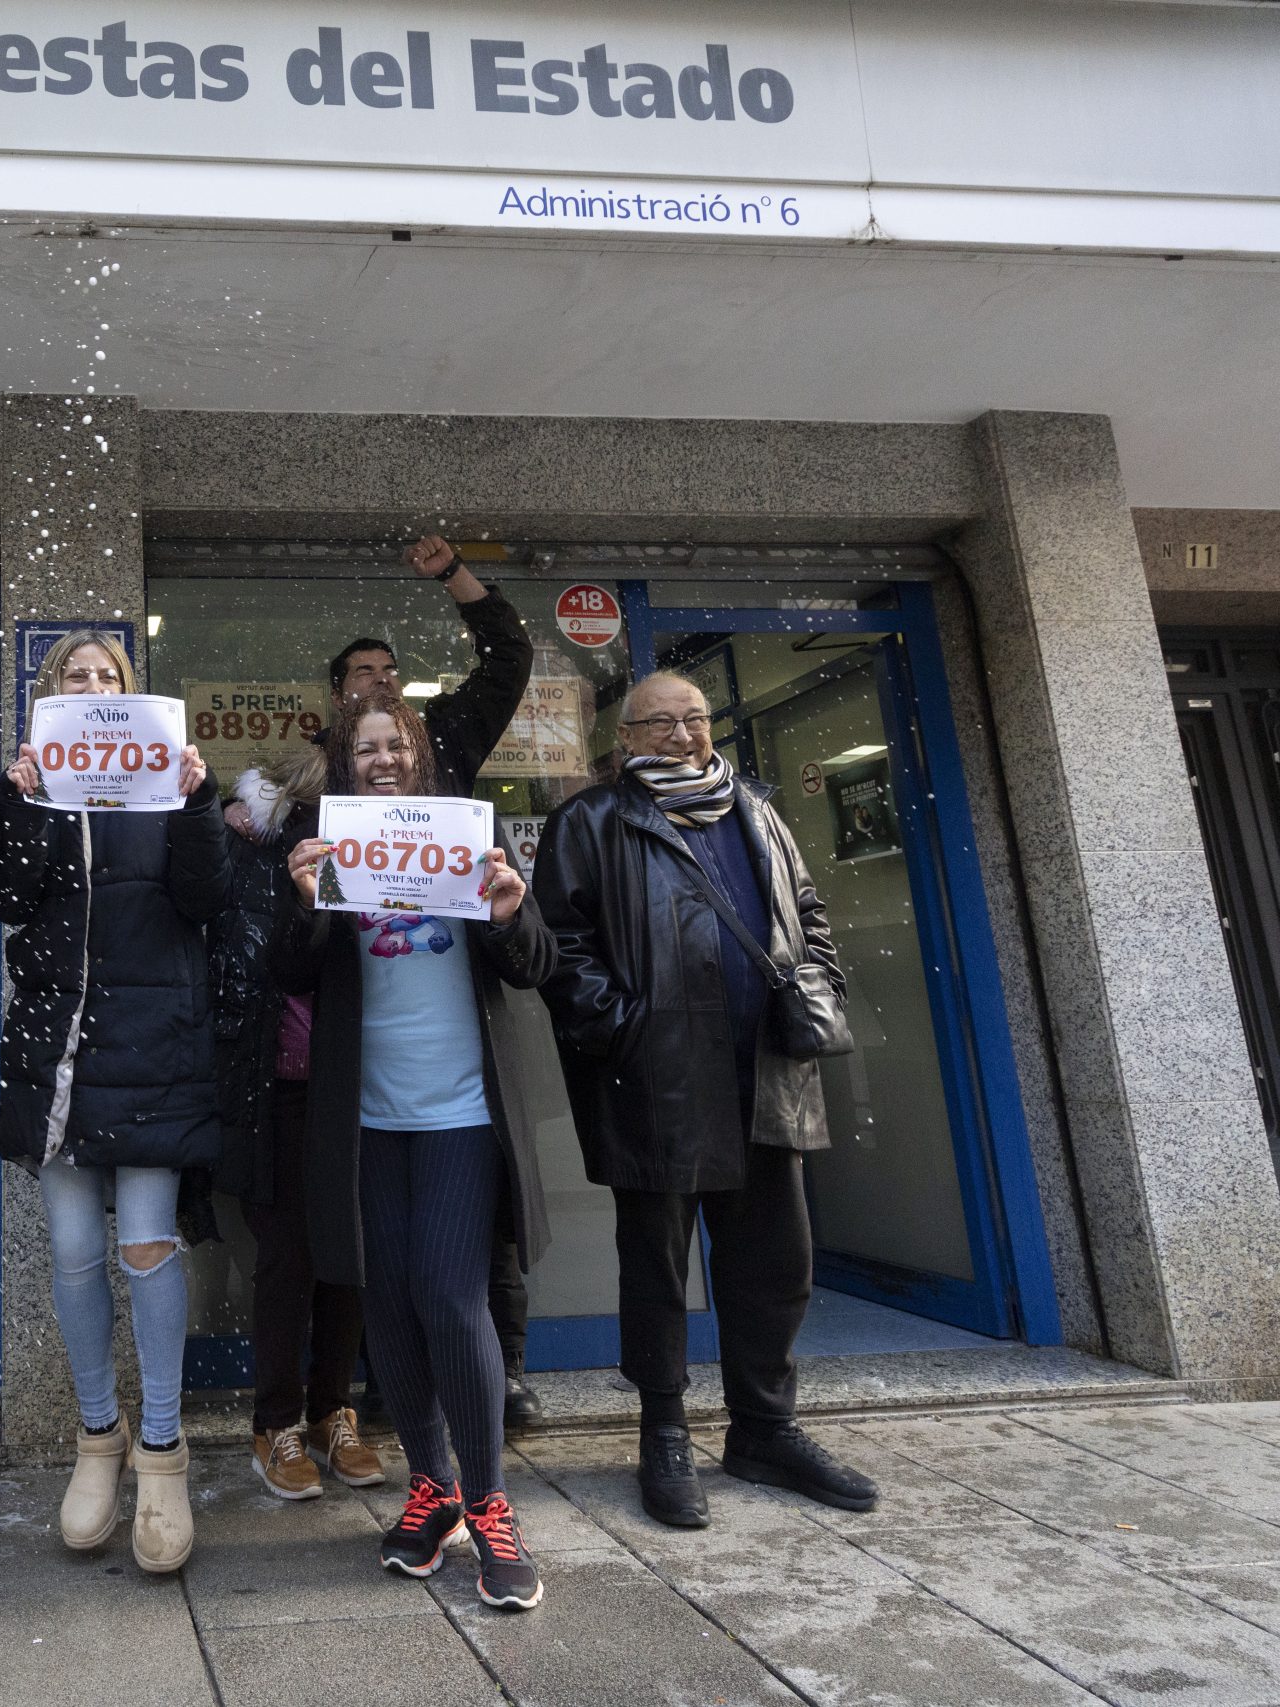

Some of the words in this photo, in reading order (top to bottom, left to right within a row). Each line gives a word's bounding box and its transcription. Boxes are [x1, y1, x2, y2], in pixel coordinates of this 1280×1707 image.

[286, 26, 435, 110] del
[470, 38, 794, 124] Estado
[498, 186, 730, 223] Administració
[780, 197, 800, 226] 6
[1190, 545, 1212, 567] 11
[569, 591, 604, 610] +18
[521, 687, 564, 699] EMIO
[91, 708, 129, 723] Niño
[92, 729, 132, 741] PREMI
[194, 711, 321, 741] 88979
[42, 742, 170, 772] 06703
[391, 808, 431, 823] Niño
[391, 829, 433, 841] PREMI
[337, 838, 473, 876] 06703
[520, 841, 537, 861] 9
